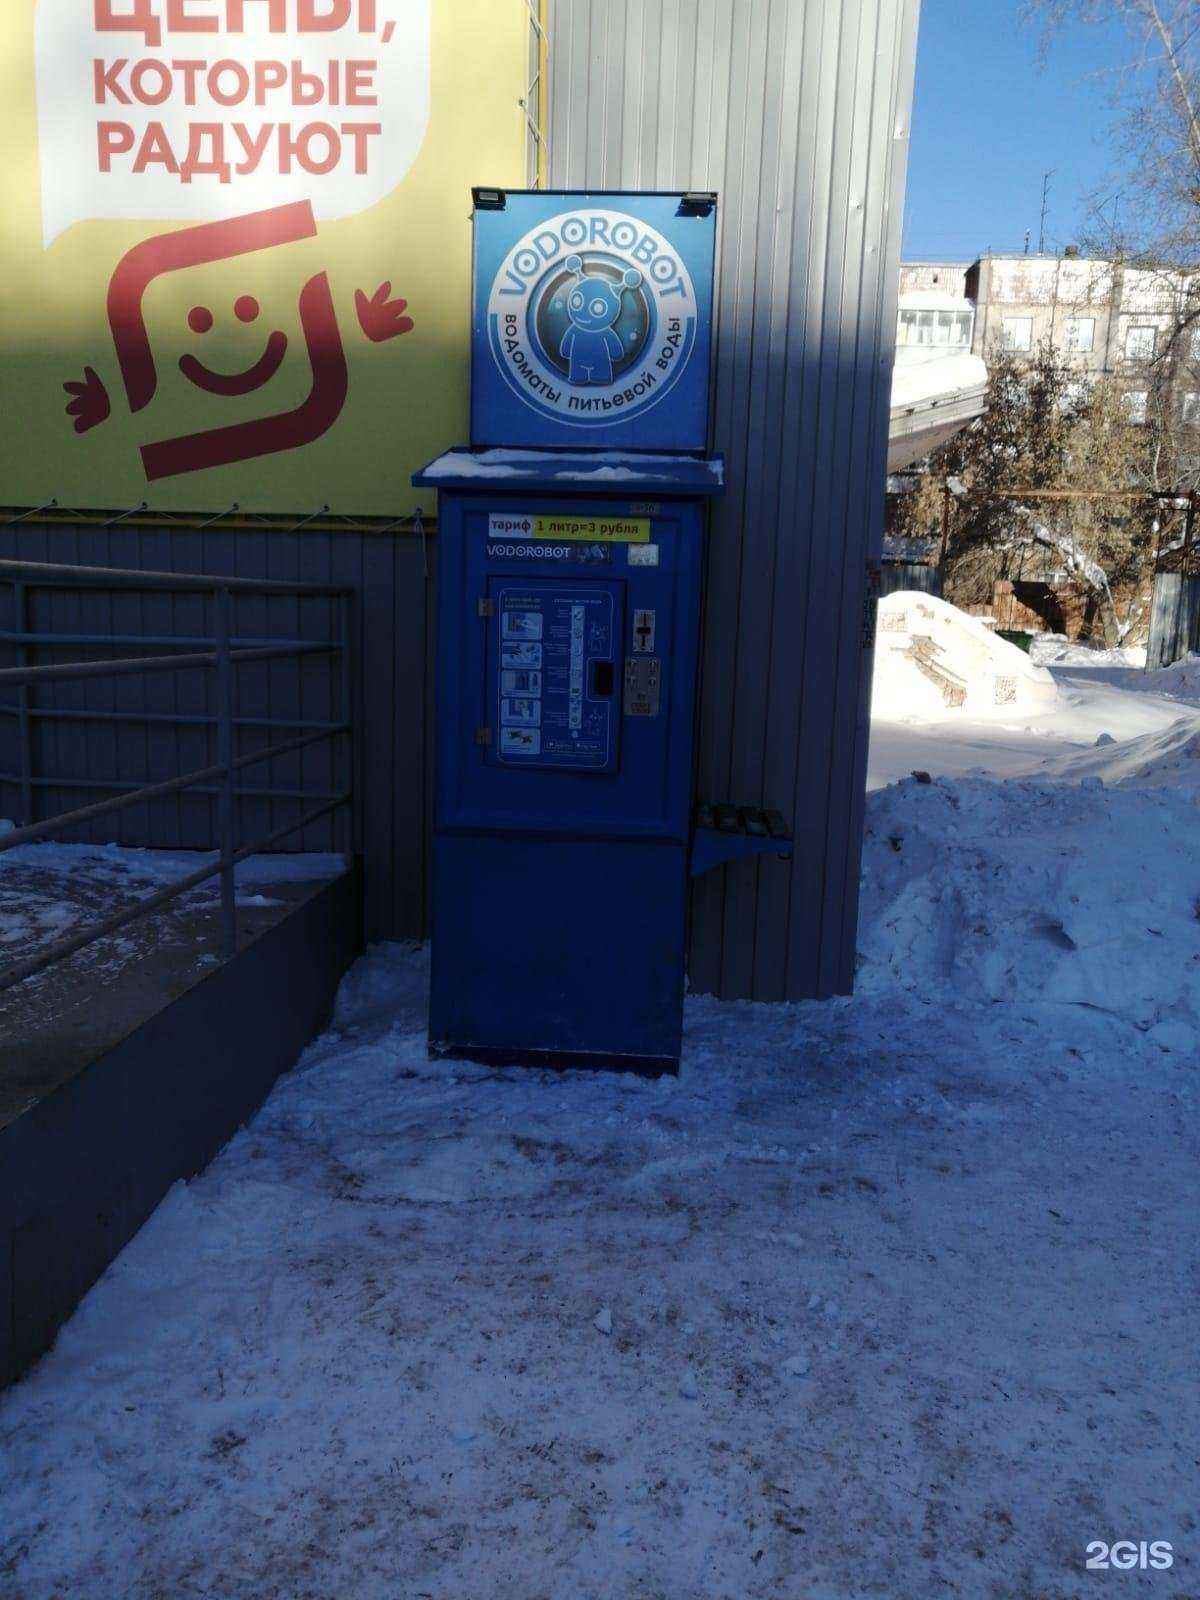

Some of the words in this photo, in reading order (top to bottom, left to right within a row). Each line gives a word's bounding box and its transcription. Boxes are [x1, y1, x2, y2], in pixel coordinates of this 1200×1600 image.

[94, 0, 396, 47] ЦЕНЫ,
[93, 58, 378, 106] КОТОРЫЕ
[97, 121, 382, 184] РАДУЮТ
[499, 217, 686, 298] VODOROBOT
[656, 317, 681, 371] ВОДЫ
[487, 544, 571, 559] VODOROBOT
[491, 519, 531, 532] тариф
[537, 520, 544, 531] 1
[600, 524, 639, 536] рубля
